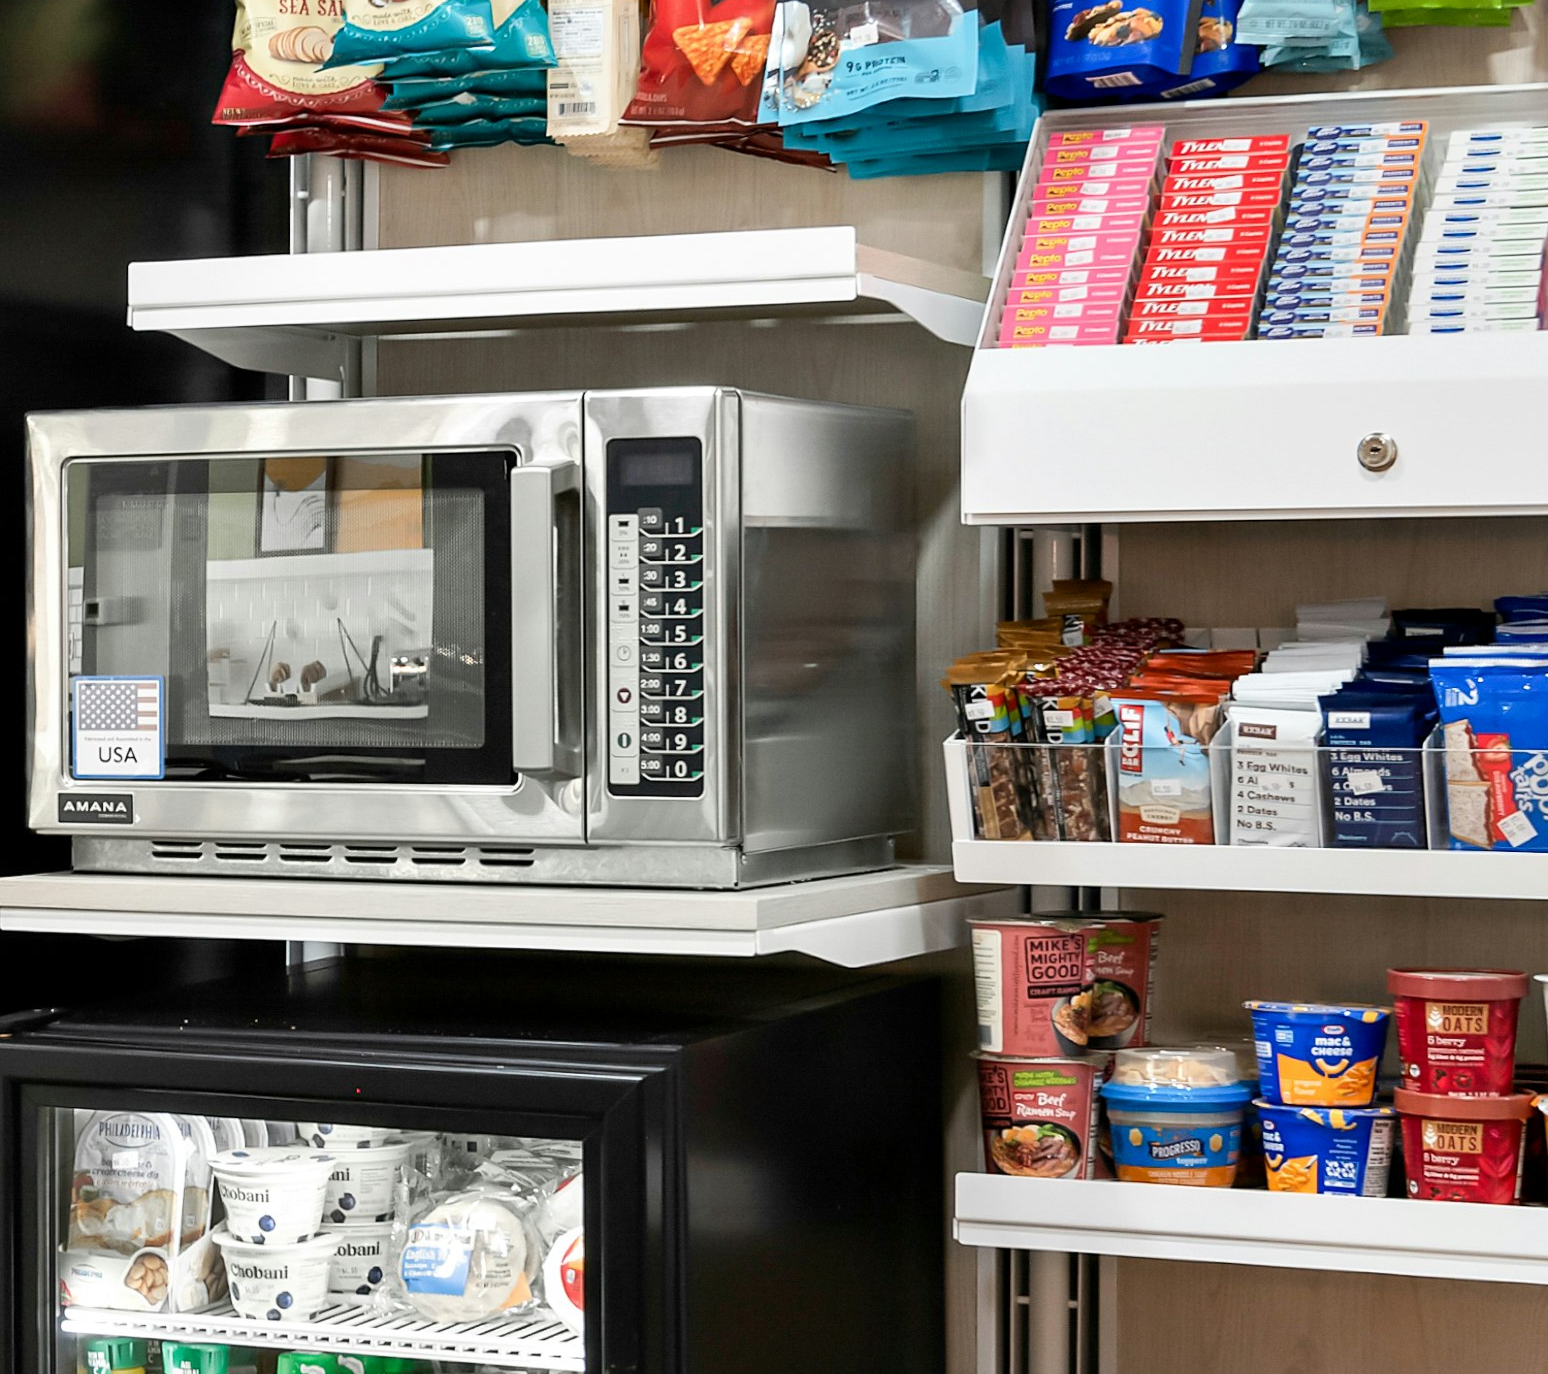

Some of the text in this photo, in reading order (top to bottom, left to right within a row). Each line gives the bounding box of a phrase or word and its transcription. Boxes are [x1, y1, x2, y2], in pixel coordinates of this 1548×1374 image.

[643, 515, 687, 533] :10 1
[675, 545, 687, 560] 2
[675, 571, 687, 587] 3
[675, 598, 687, 615] 4
[641, 624, 687, 642] 1:00 5
[675, 653, 687, 669] 6
[675, 680, 687, 696] 7
[675, 707, 687, 723] 8
[675, 734, 687, 750] 9
[98, 747, 138, 763] USA
[1340, 753, 1403, 763] Egg Whites
[675, 761, 687, 777] 0
[1247, 762, 1308, 775] Egg Whites
[1247, 791, 1295, 803] Cashews
[1344, 797, 1376, 806] Dates
[63, 801, 127, 812] AMANA
[1247, 806, 1278, 816] Dates
[1335, 812, 1376, 821] No B.S.
[1139, 826, 1181, 835] CRUNCHY
[1237, 820, 1277, 831] No B.S.
[1029, 938, 1081, 952] MIKE'S
[1031, 953, 1081, 964] MIGHTY
[1098, 952, 1125, 964] Beef
[1031, 965, 1080, 979] GOOD
[1442, 1006, 1483, 1017] MODERN
[1443, 1017, 1483, 1033] OATS
[1037, 1092, 1066, 1107] Beef
[1015, 1103, 1076, 1120] Ramen Soup
[98, 1122, 161, 1141] PHILADELPHIA
[1437, 1123, 1477, 1135] MODERN
[1152, 1139, 1202, 1158] PROGRESSO
[1437, 1135, 1476, 1150] OATS
[231, 1263, 289, 1280] Chobani
